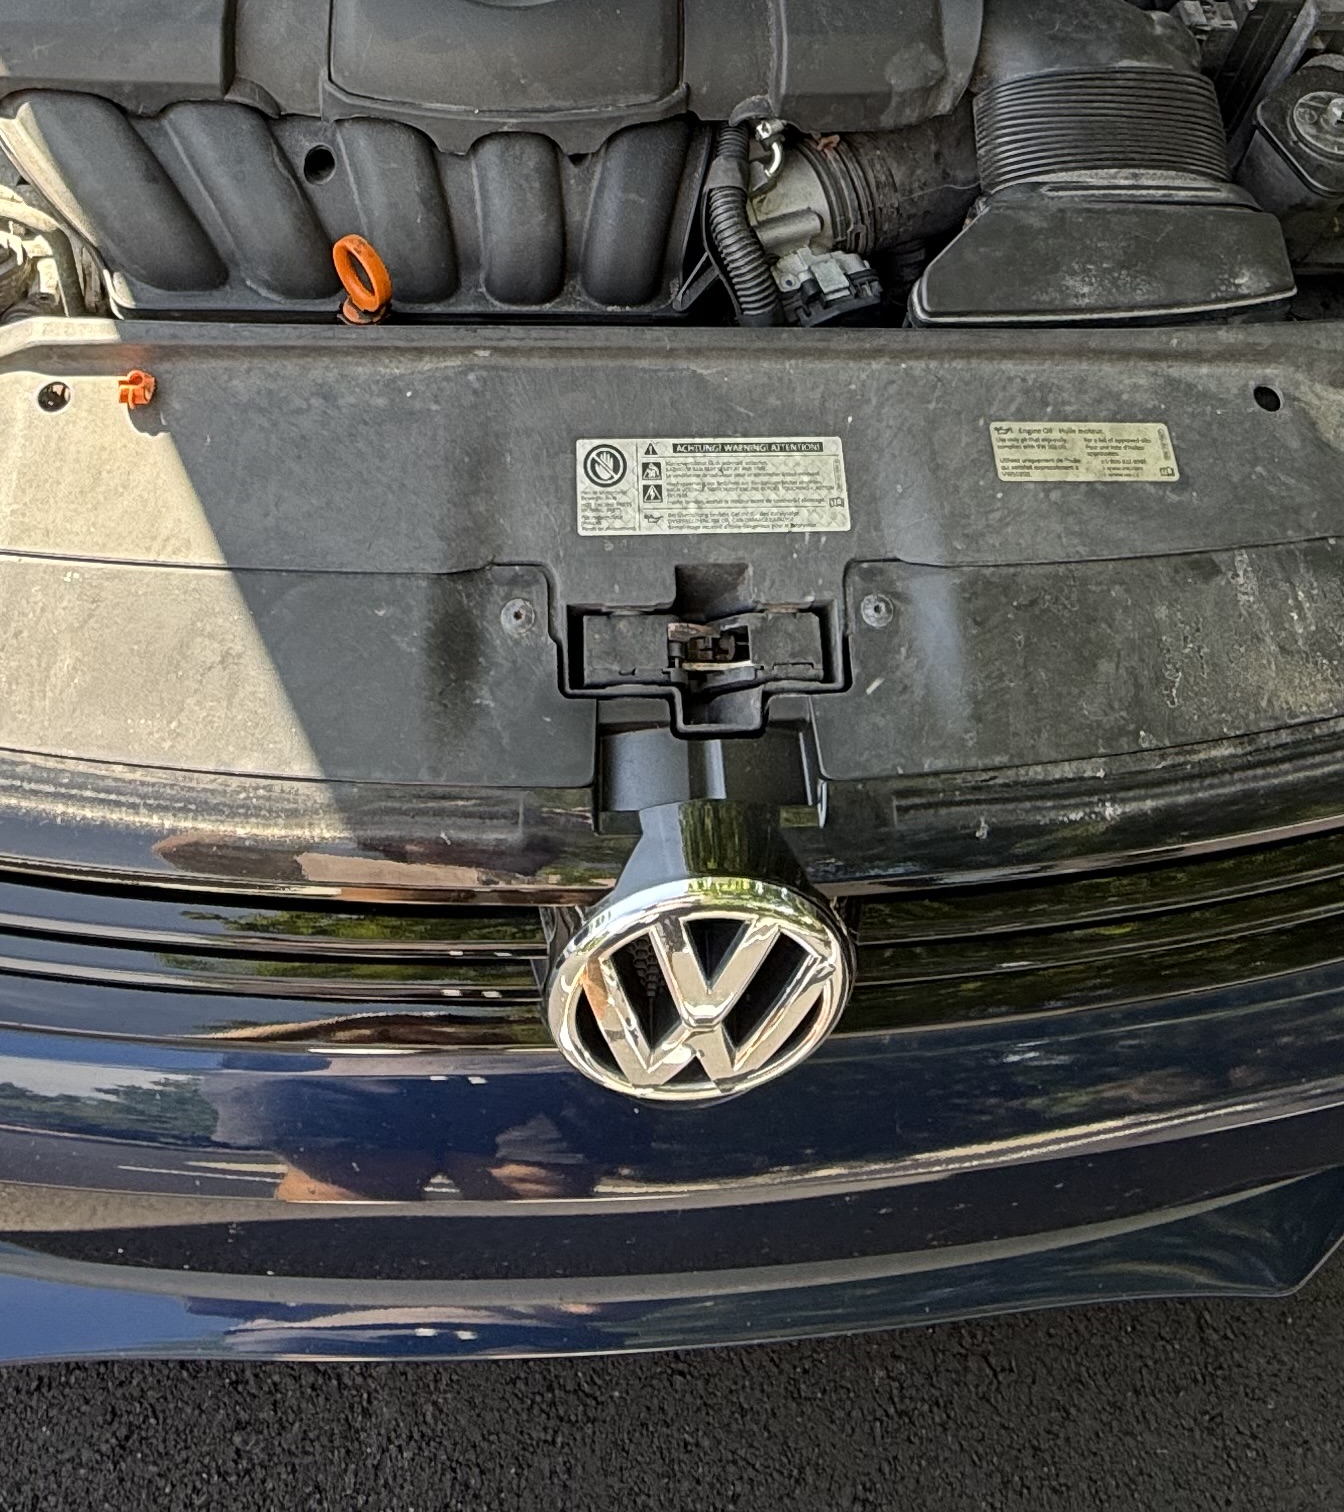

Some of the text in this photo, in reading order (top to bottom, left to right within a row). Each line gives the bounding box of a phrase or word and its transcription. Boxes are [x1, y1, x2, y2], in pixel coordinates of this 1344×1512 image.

[1019, 427, 1041, 435] Engine
[676, 443, 820, 453] ACHTUNG! WARNING! ATTENTION!
[571, 904, 837, 1094] VW
